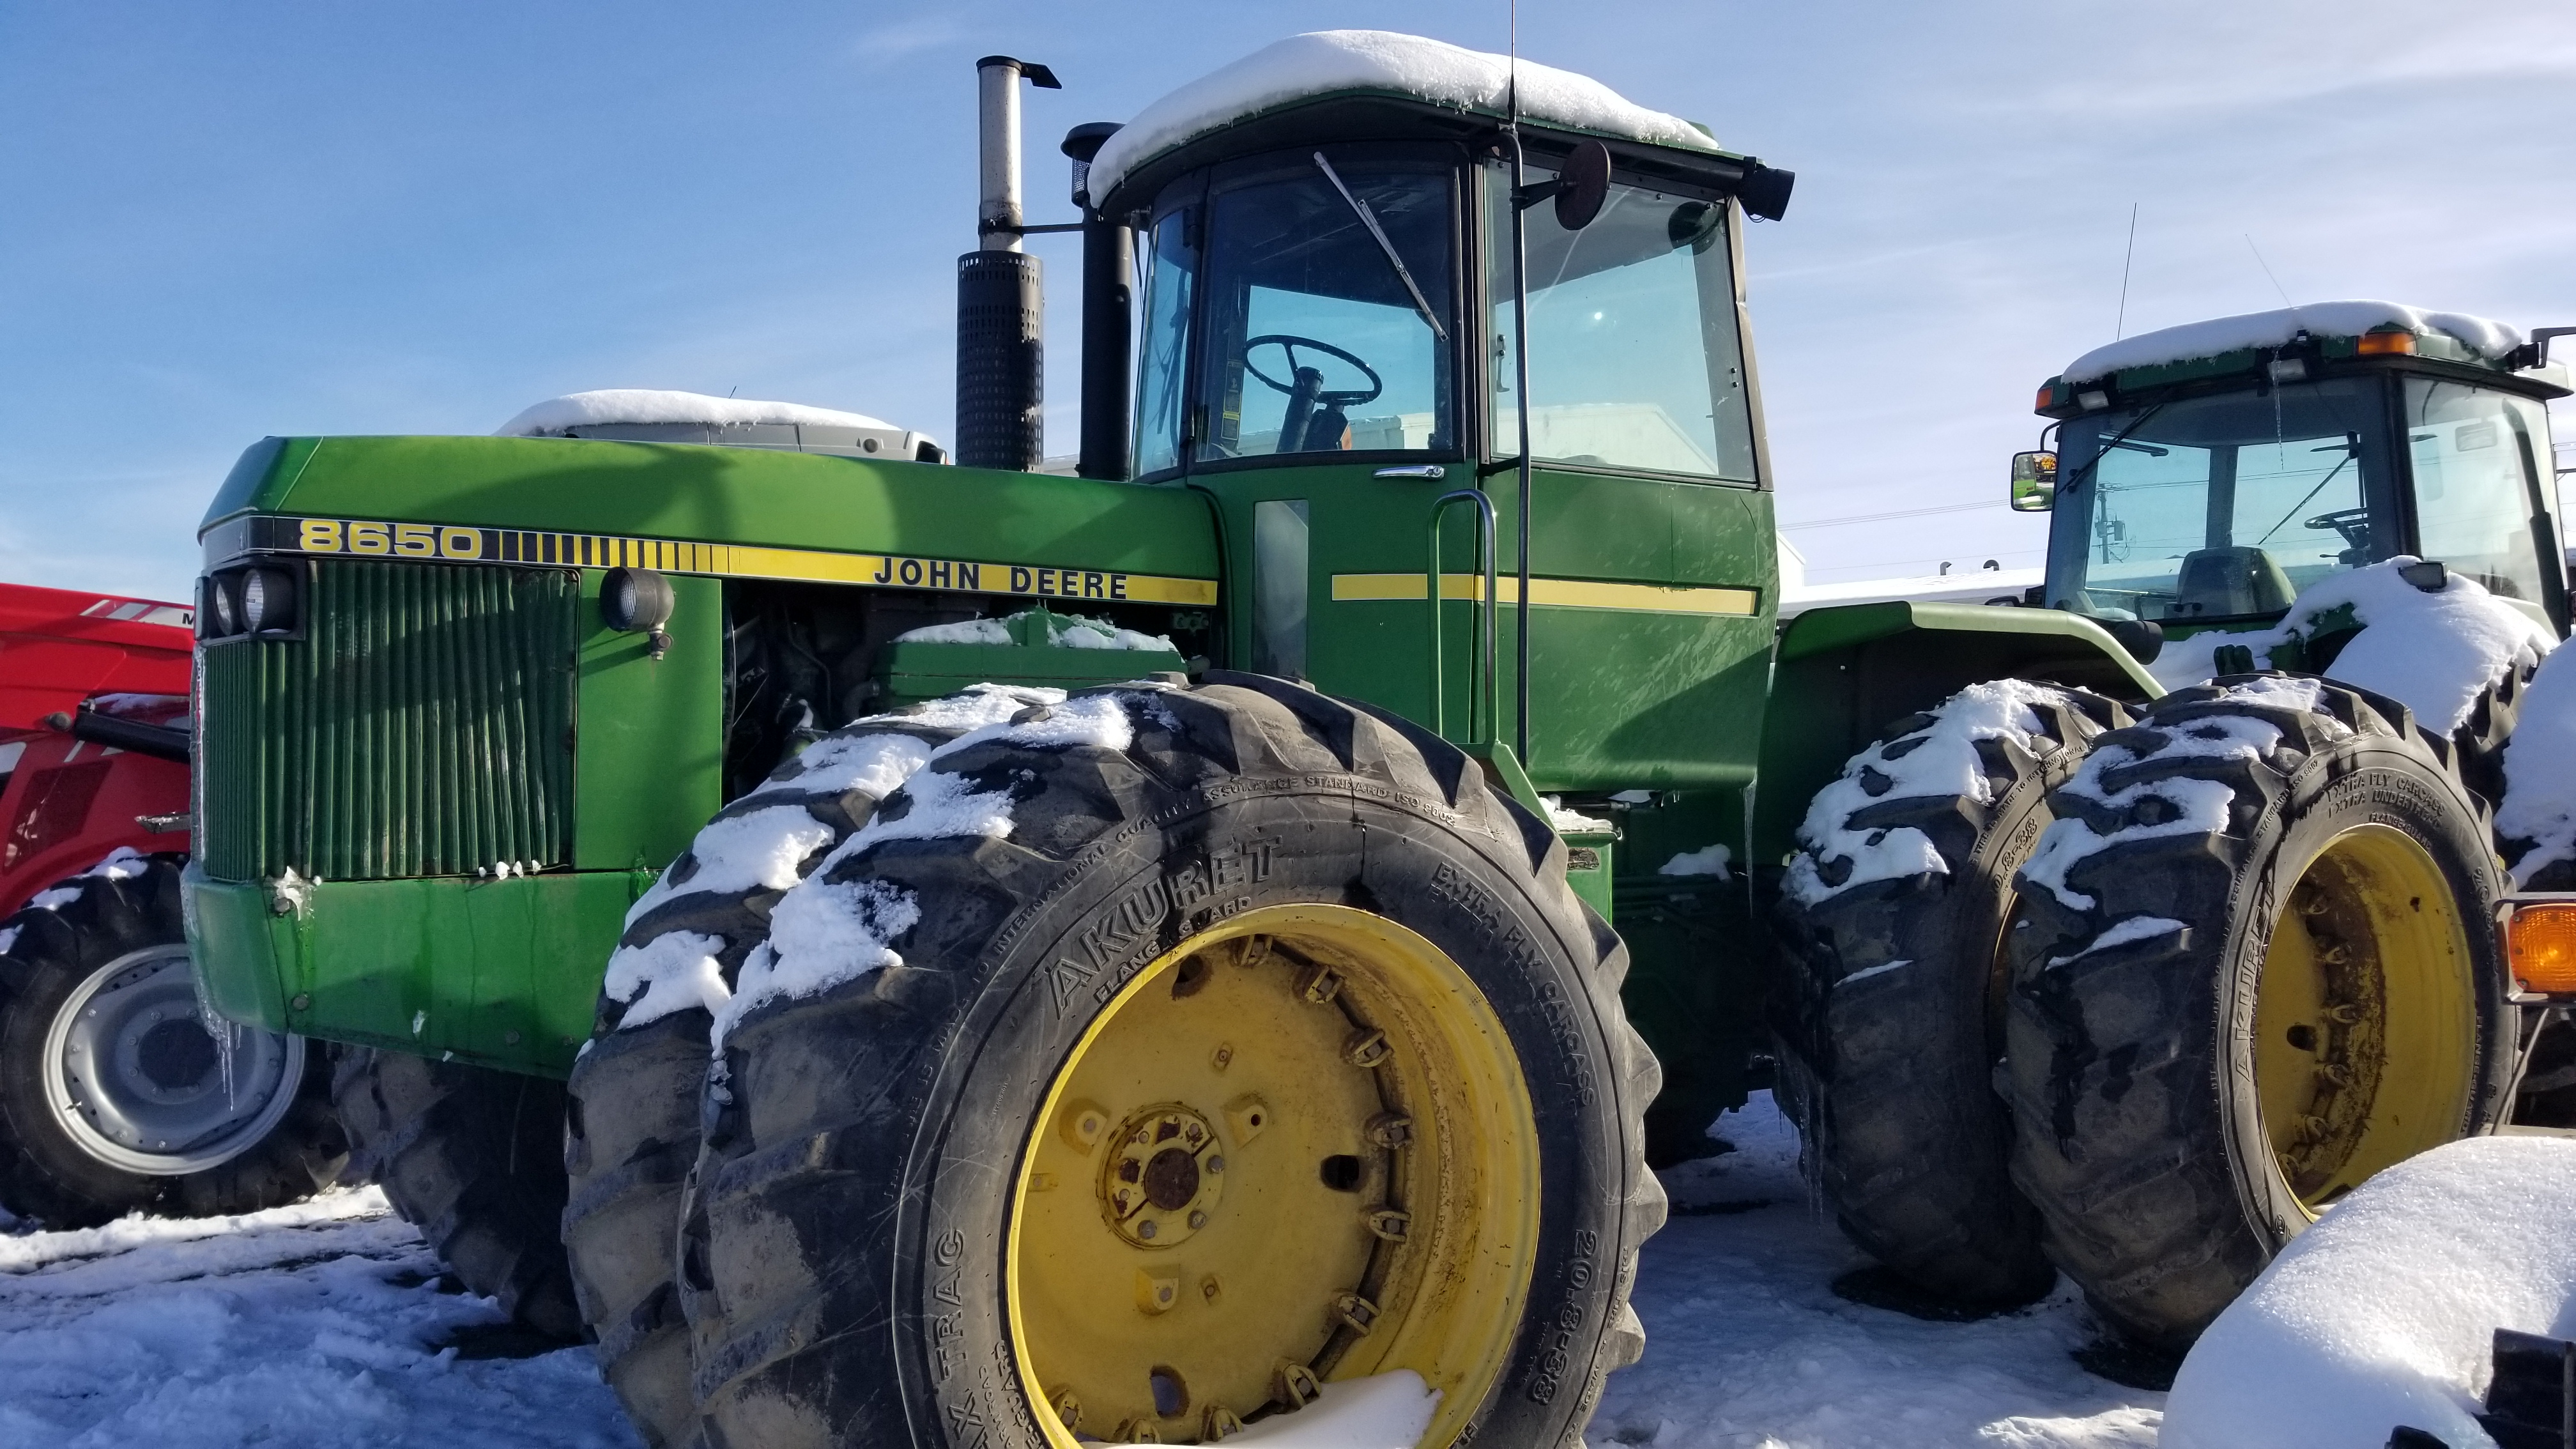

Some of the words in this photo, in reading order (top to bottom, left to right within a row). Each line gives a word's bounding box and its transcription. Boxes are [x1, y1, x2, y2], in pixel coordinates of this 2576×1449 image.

[299, 518, 482, 560] 8650
[875, 556, 980, 590] JOHN
[1011, 566, 1128, 600] DEERE
[1306, 776, 1389, 798] STANDARD
[1395, 792, 1421, 808] ISO
[1423, 802, 1456, 827] 9002
[2016, 781, 2027, 793] TO
[2291, 773, 2304, 791] ISO
[1992, 817, 2037, 893] 0.8-38
[1048, 834, 1282, 1020] AKURET
[1433, 861, 1503, 929] EXTRA
[1543, 980, 1595, 1107] CARCASS
[933, 1229, 968, 1381] TRAC
[1533, 1229, 1598, 1406] 20.8-38
